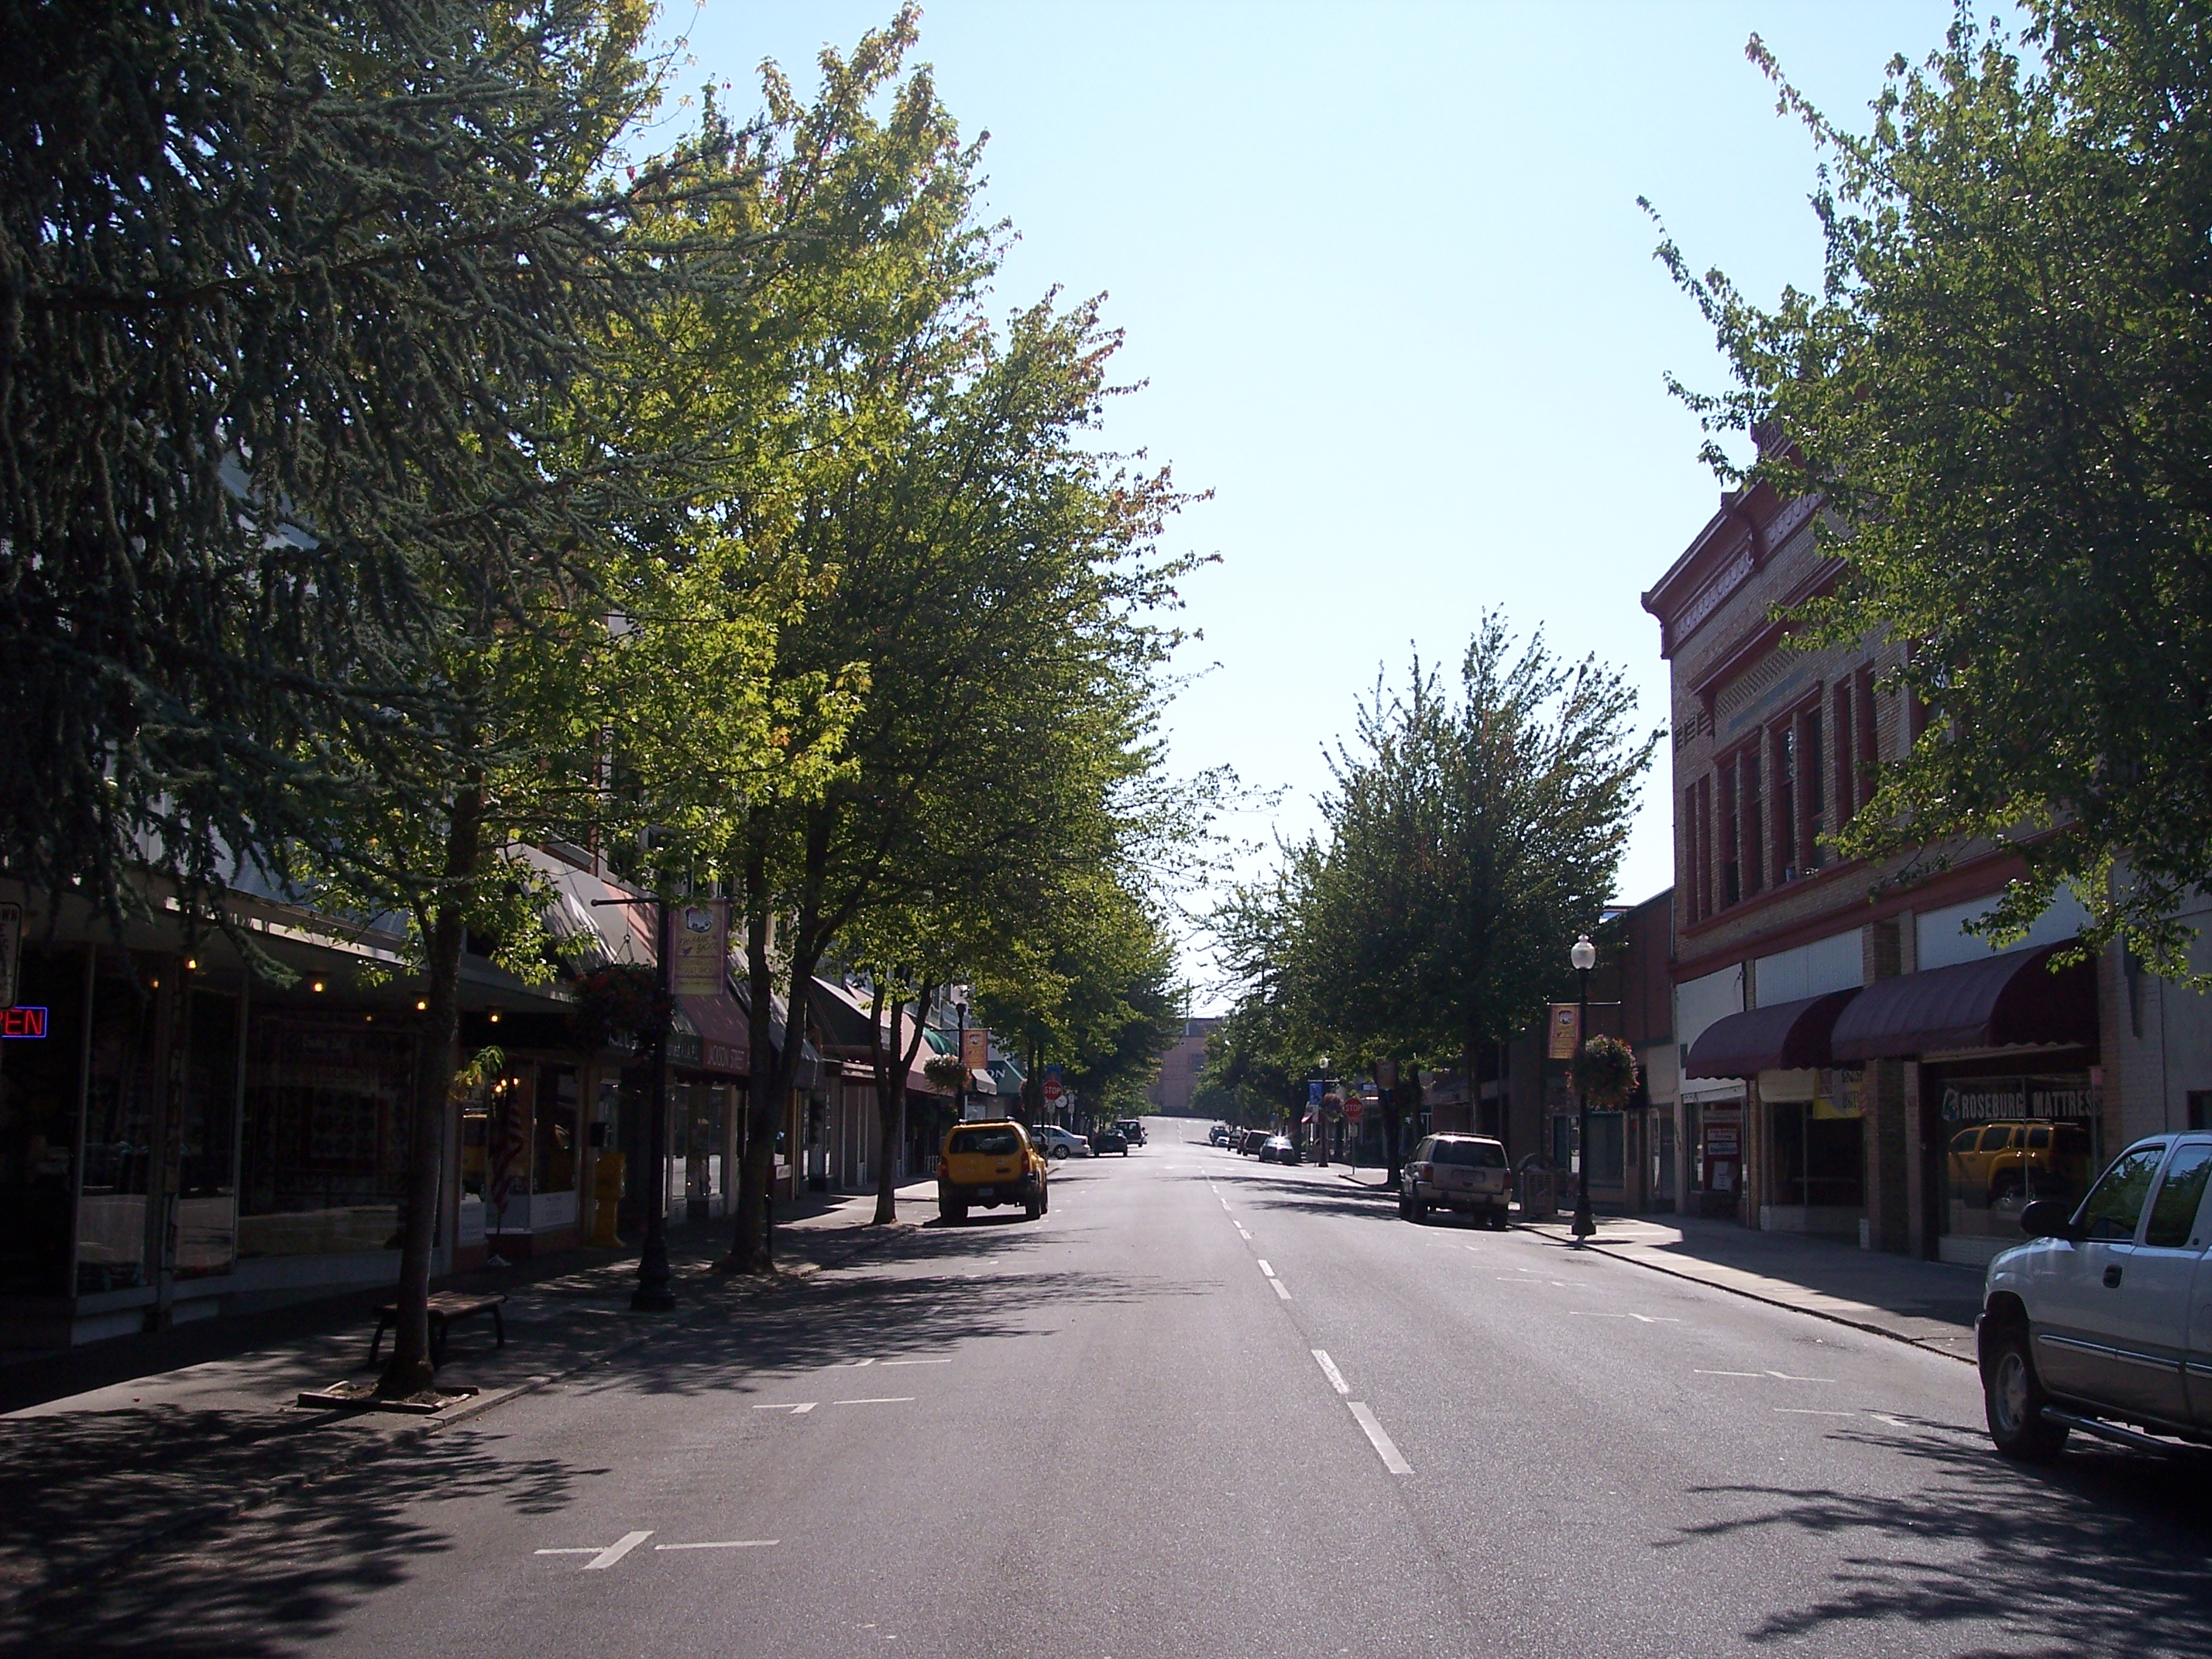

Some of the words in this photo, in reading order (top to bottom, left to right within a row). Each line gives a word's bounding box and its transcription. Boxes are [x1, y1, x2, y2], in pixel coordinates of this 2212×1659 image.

[0, 1009, 43, 1036] EN
[1044, 1086, 1061, 1094] STOP
[1345, 1104, 1362, 1112] STOP
[1962, 1092, 2025, 1119] ROSEBURG
